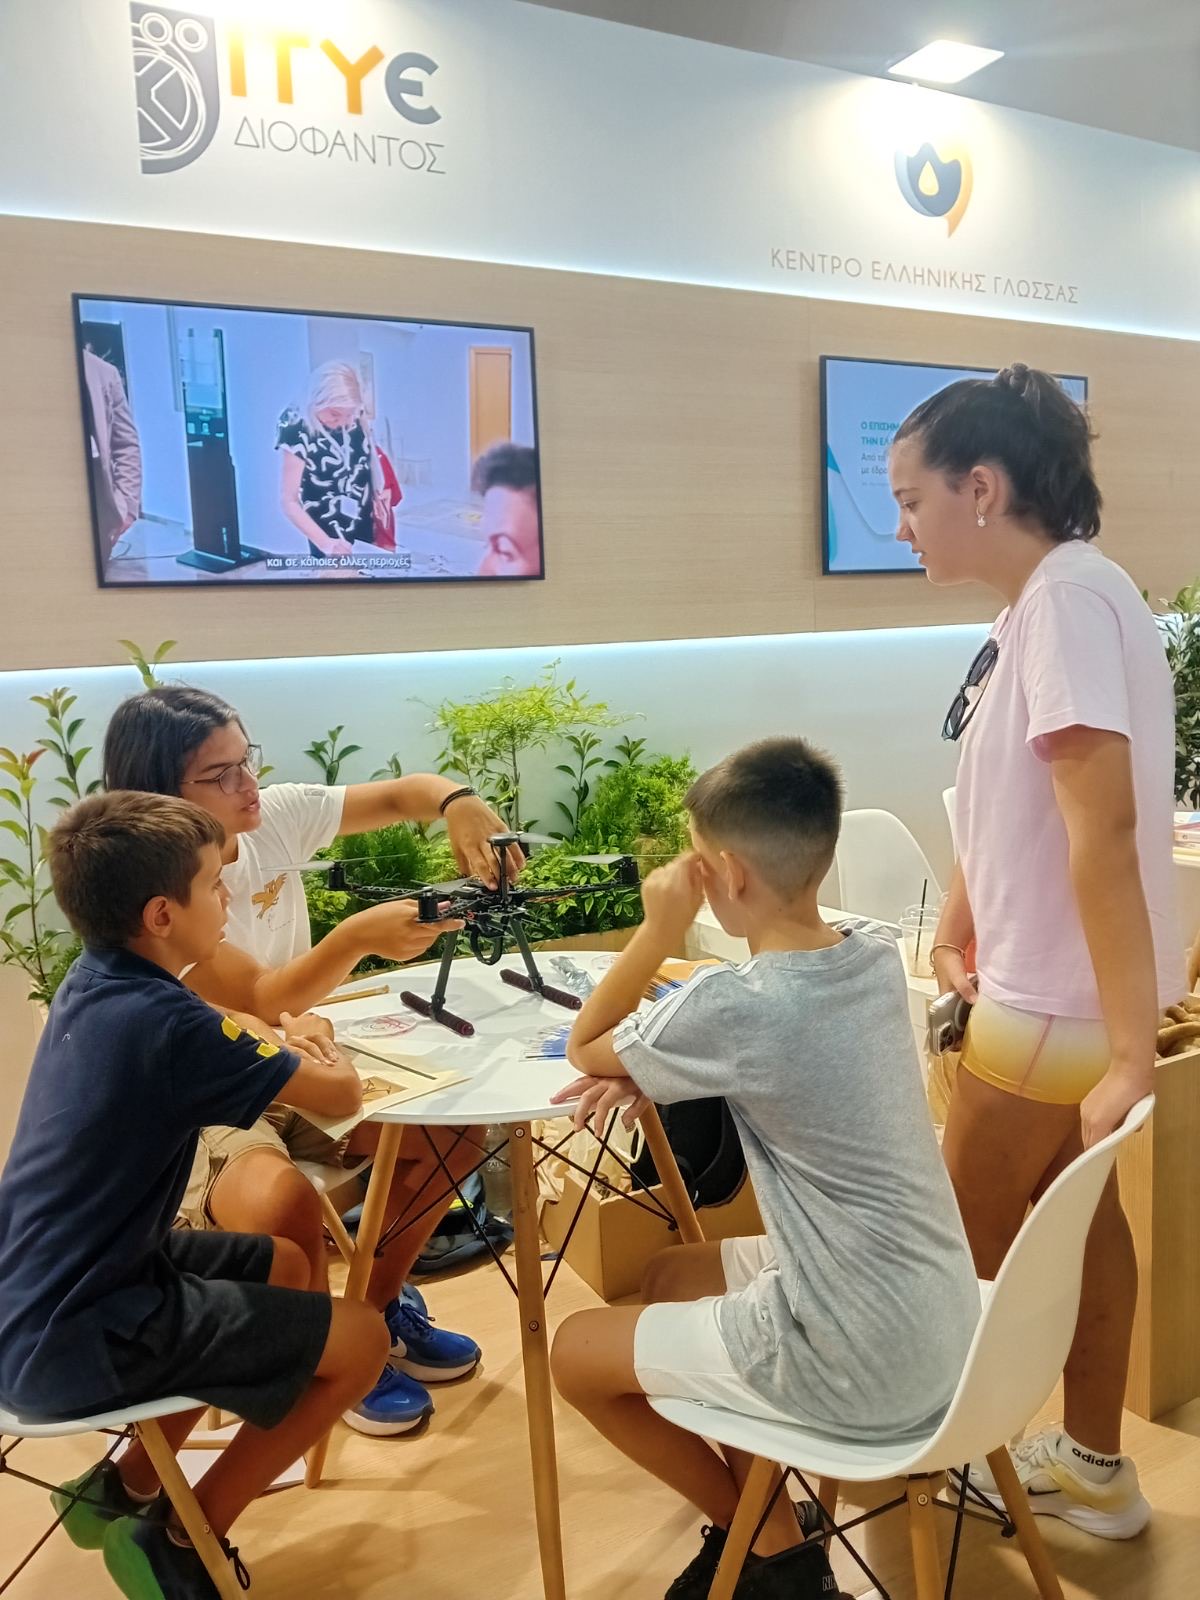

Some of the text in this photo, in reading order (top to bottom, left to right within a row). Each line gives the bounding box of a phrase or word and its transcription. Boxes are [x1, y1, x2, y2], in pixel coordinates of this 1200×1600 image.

[234, 116, 446, 175] ΔΙΟΦΑΝΤΟΣ
[771, 248, 1079, 304] ΚΕΝΤΡΟ ΕΛΛΗΝΙΚΗΣ ΓΛΩΣΣΑΣ
[267, 555, 410, 570] και σε κάποιες άλλες περιοχές
[1072, 1447, 1121, 1468] adidas
